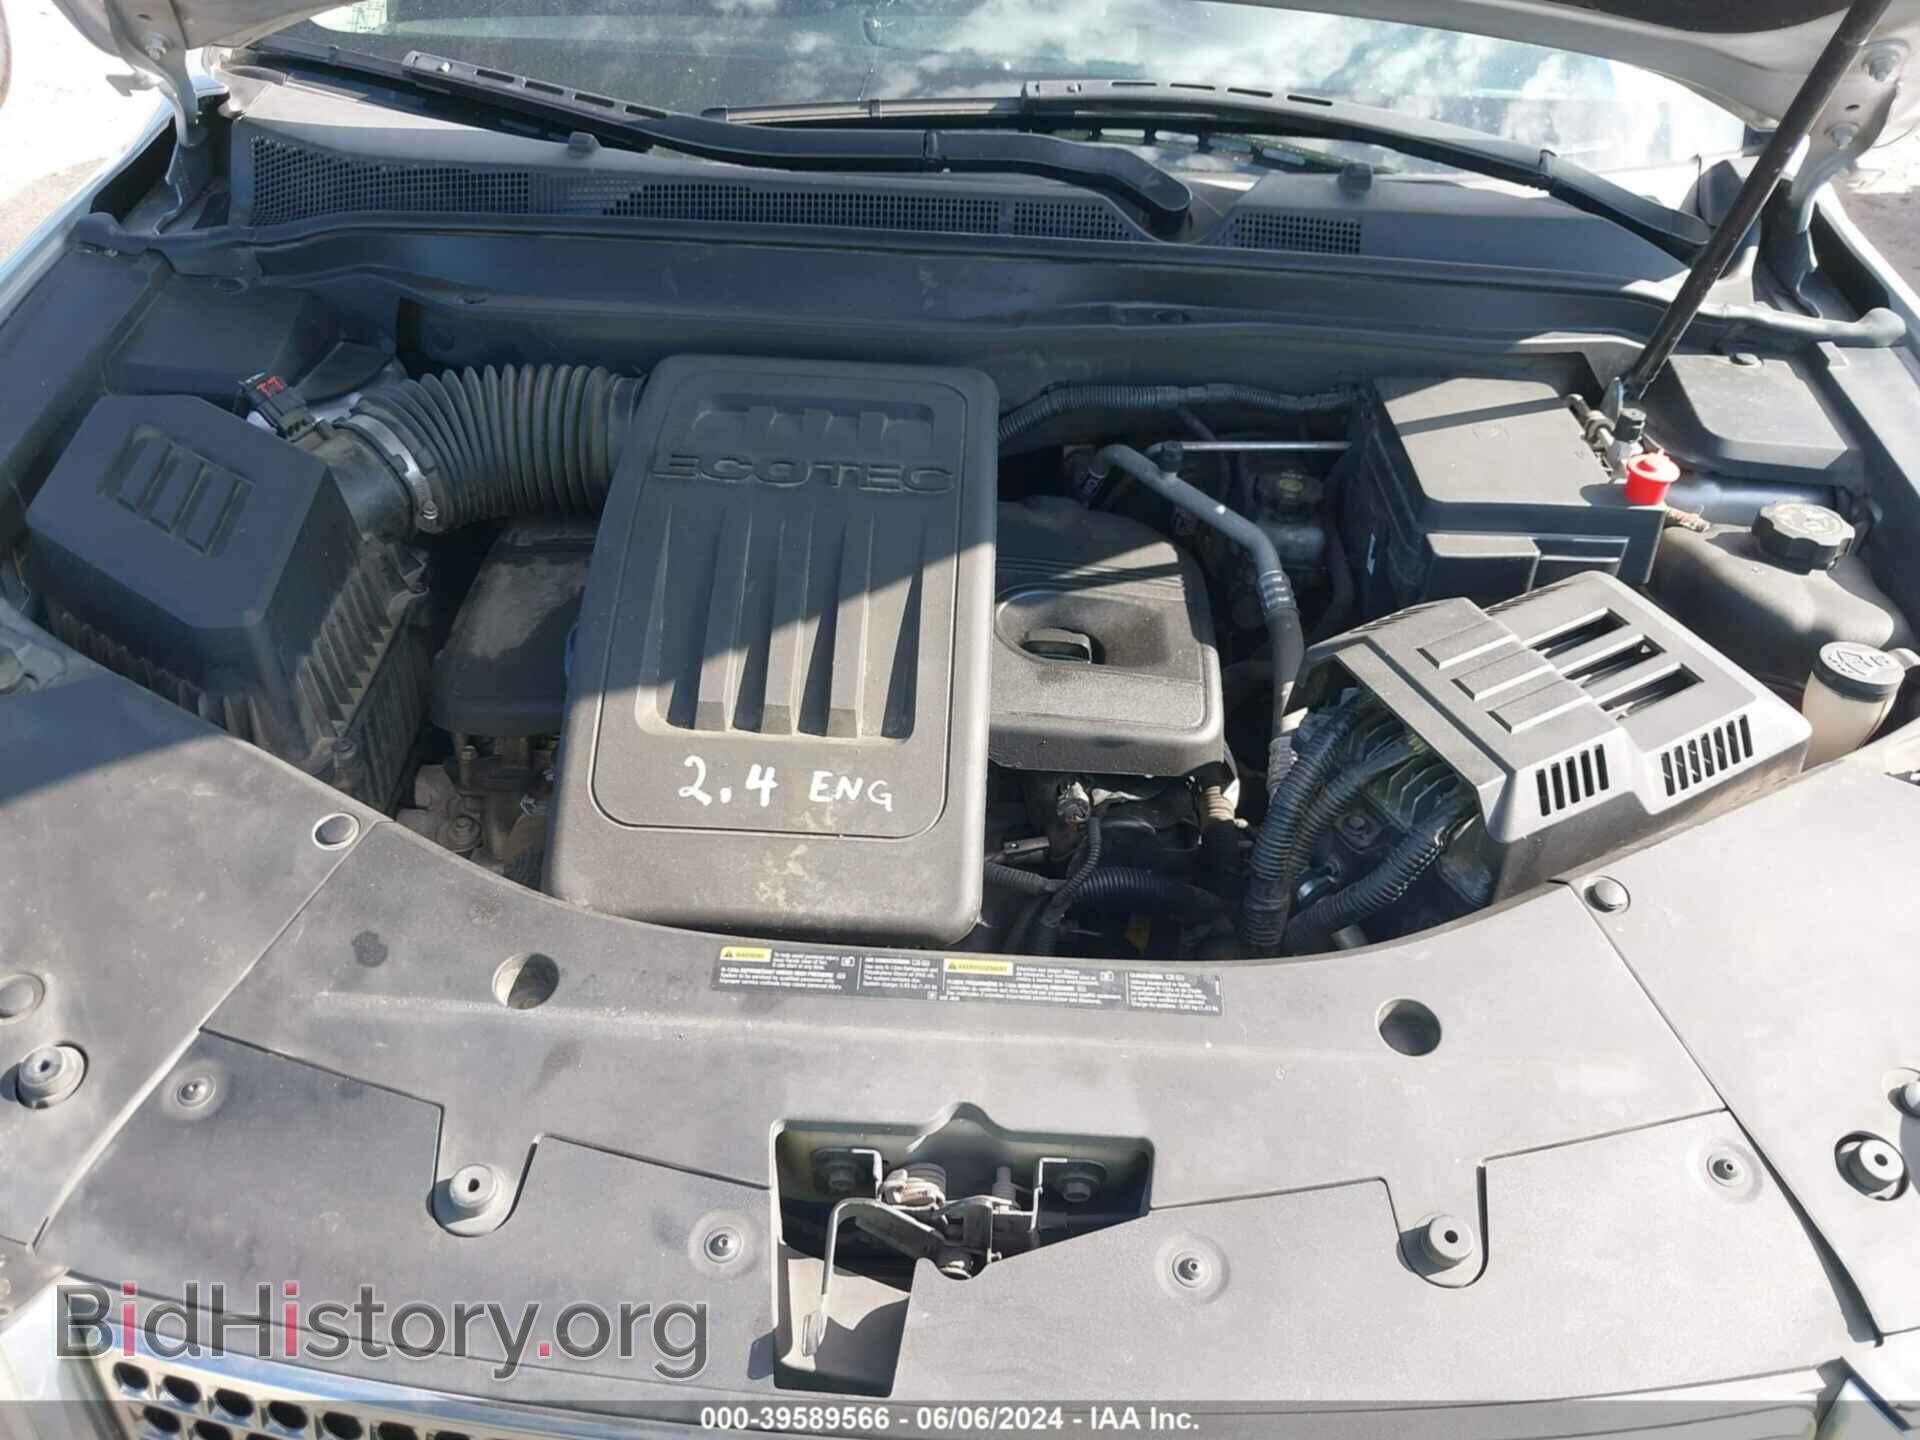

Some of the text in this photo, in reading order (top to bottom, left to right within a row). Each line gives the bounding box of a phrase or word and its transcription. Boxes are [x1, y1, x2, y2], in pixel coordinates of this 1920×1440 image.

[651, 453, 953, 494] ECOTEC
[678, 755, 893, 812] 2.4 ENG
